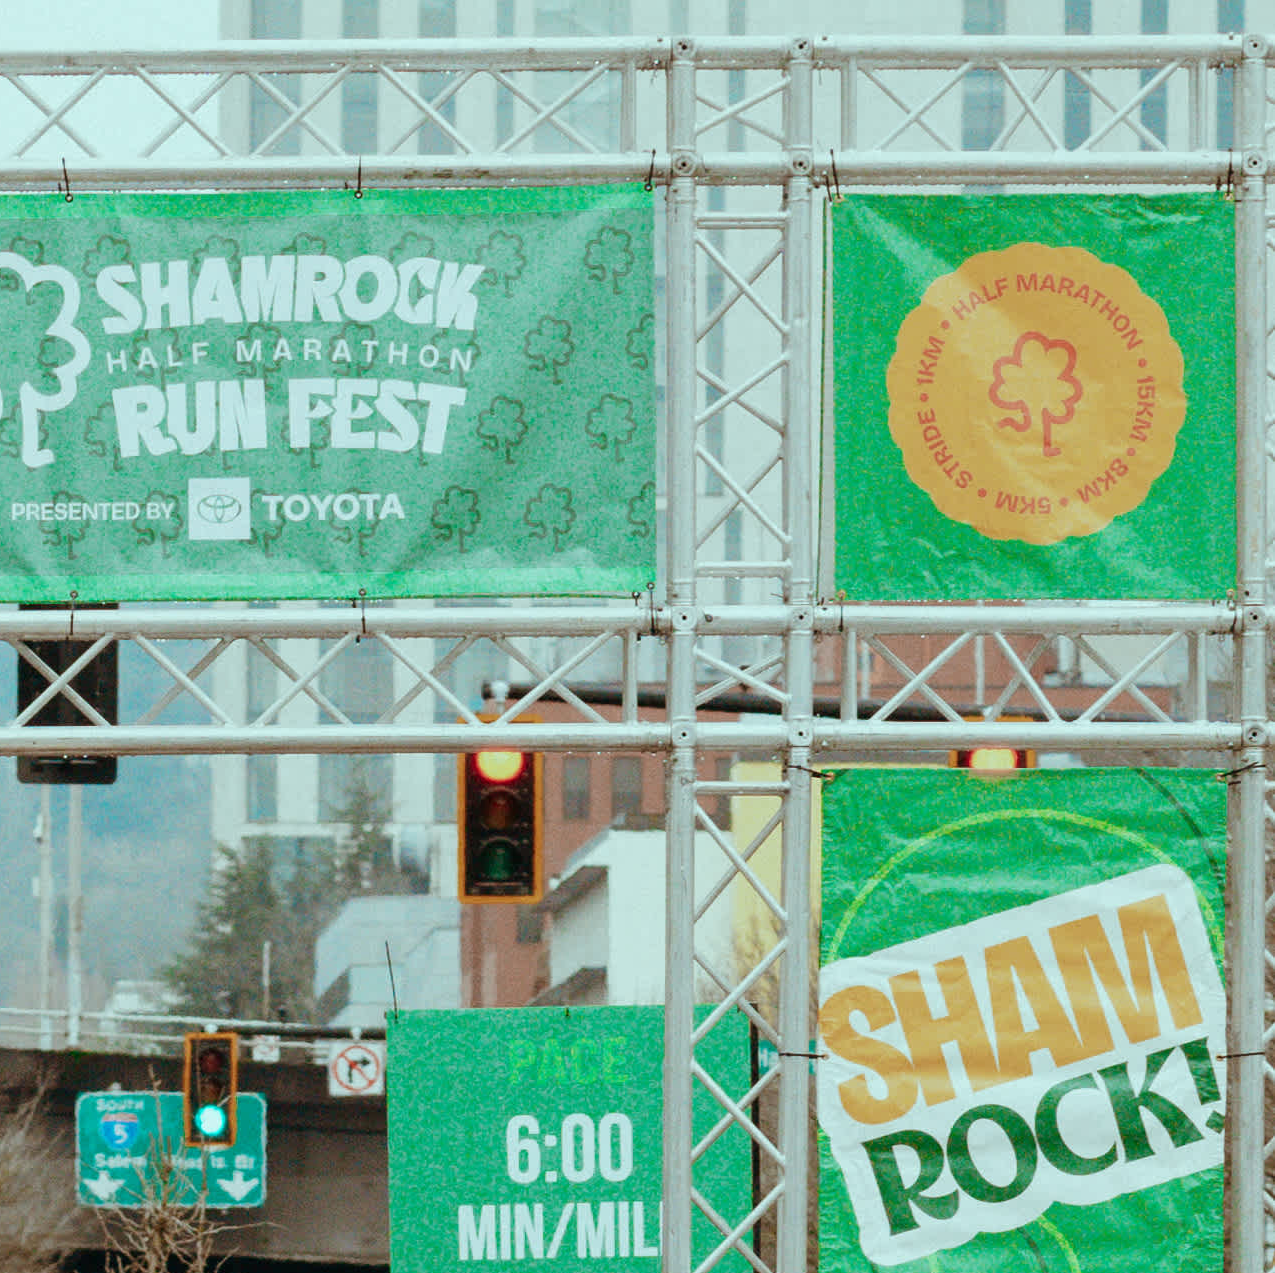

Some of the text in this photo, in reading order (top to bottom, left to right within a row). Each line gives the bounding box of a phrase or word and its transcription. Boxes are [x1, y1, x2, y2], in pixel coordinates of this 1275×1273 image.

[96, 254, 486, 335] SHAMROCK
[105, 337, 475, 374] HALF MARATHON
[111, 377, 466, 458] RUN FEST
[916, 273, 1156, 515] HALF MARATHON 15KM 8KM 5KM STRIDE 1KM
[11, 493, 406, 521] PRESENTED BY TOYOTA
[818, 894, 1203, 1125] SHAM
[508, 1036, 630, 1087] PACE
[113, 1123, 129, 1144] 5
[505, 1112, 634, 1184] 6:00
[861, 1038, 1225, 1236] ROCK!
[457, 1201, 663, 1261] MIN/MIL
